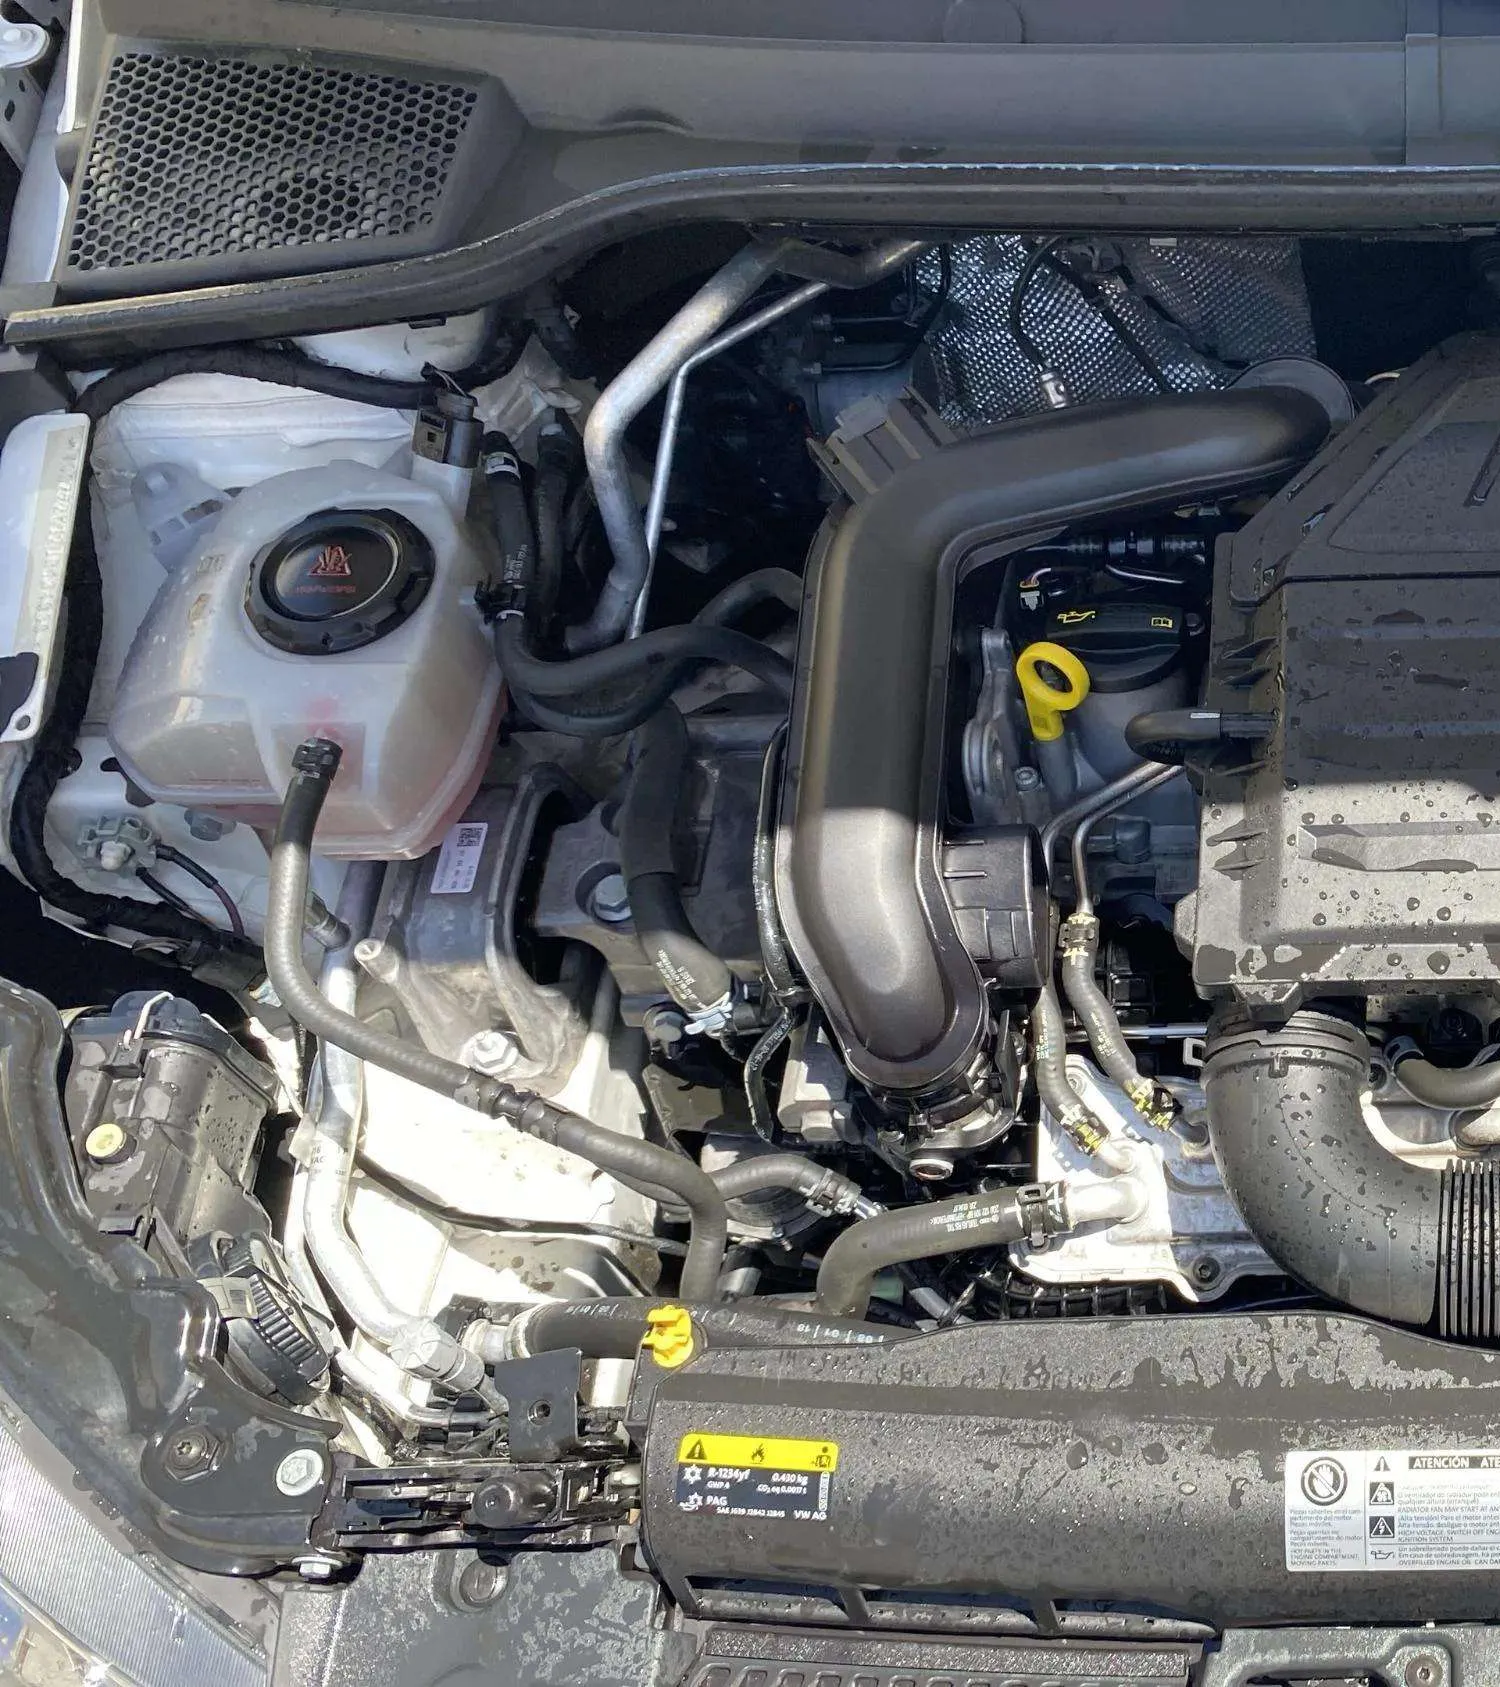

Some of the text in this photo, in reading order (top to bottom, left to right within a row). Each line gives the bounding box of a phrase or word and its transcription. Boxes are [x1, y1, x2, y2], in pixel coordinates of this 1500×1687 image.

[1413, 1456, 1469, 1468] ATENCIÓN
[708, 1468, 750, 1482] R-1234yf
[796, 1474, 808, 1485] kg
[706, 1496, 727, 1506] PAG
[793, 1510, 827, 1521] VW AG
